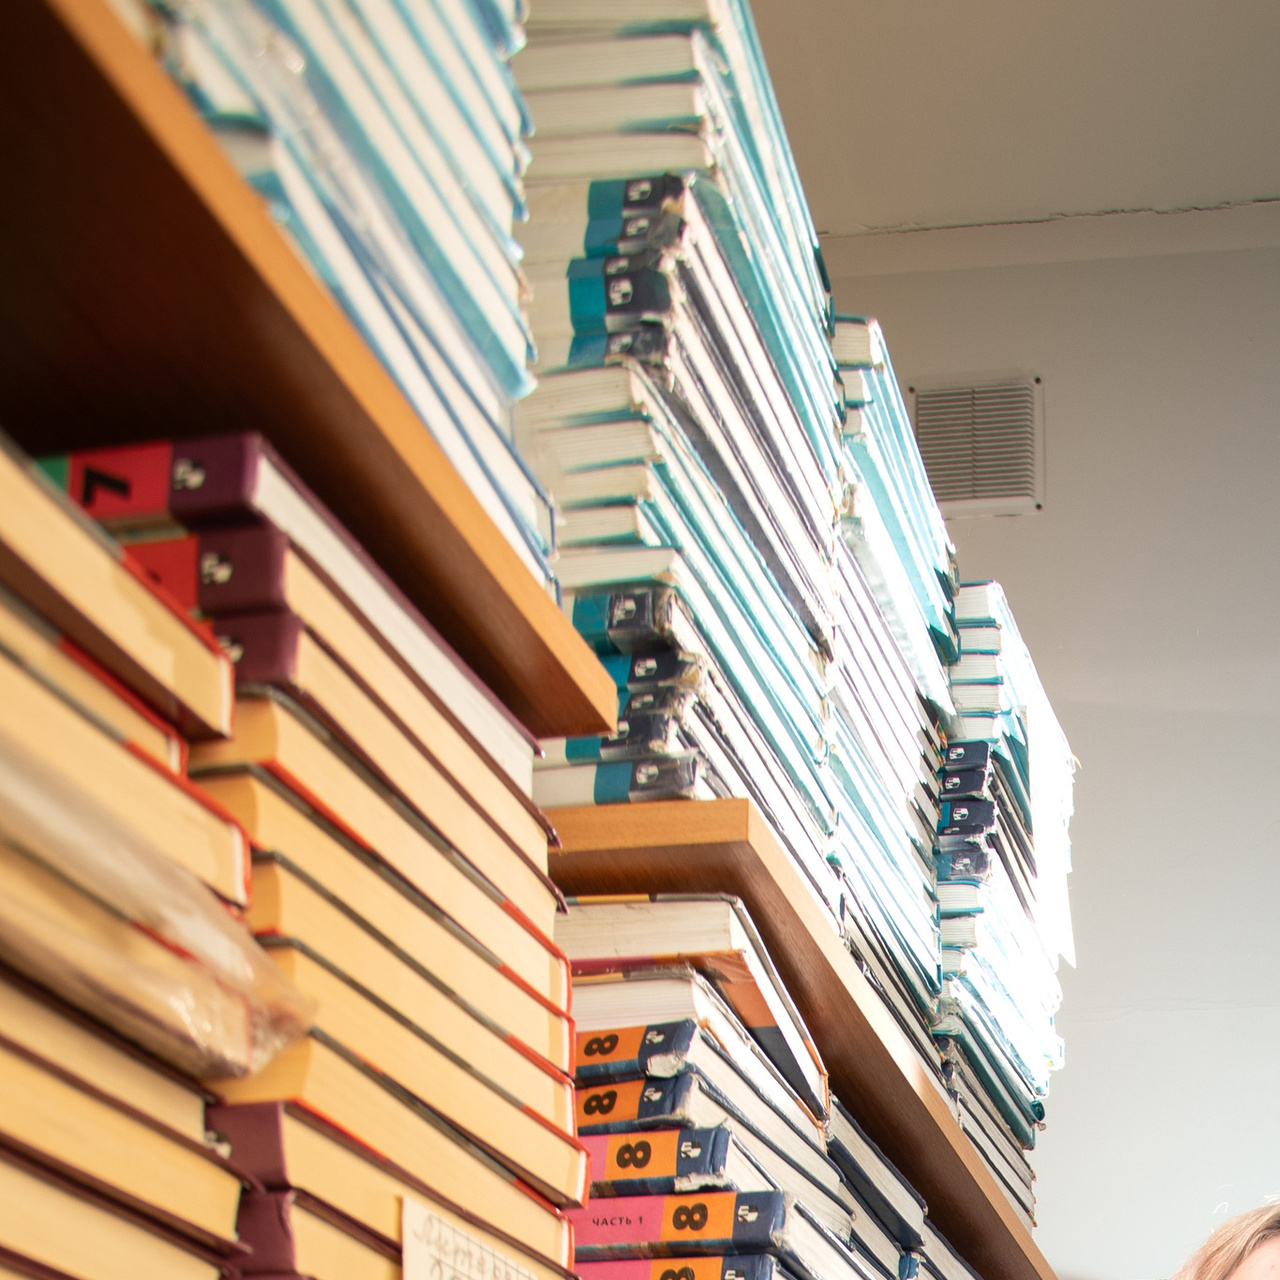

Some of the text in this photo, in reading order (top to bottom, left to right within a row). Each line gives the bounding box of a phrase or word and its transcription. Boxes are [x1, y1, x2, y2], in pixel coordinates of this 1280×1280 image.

[584, 1033, 619, 1056] 8
[583, 1090, 617, 1115] 8
[616, 1140, 651, 1168] 8
[592, 1216, 632, 1226] ЧАСТЬ
[672, 1202, 708, 1231] 8
